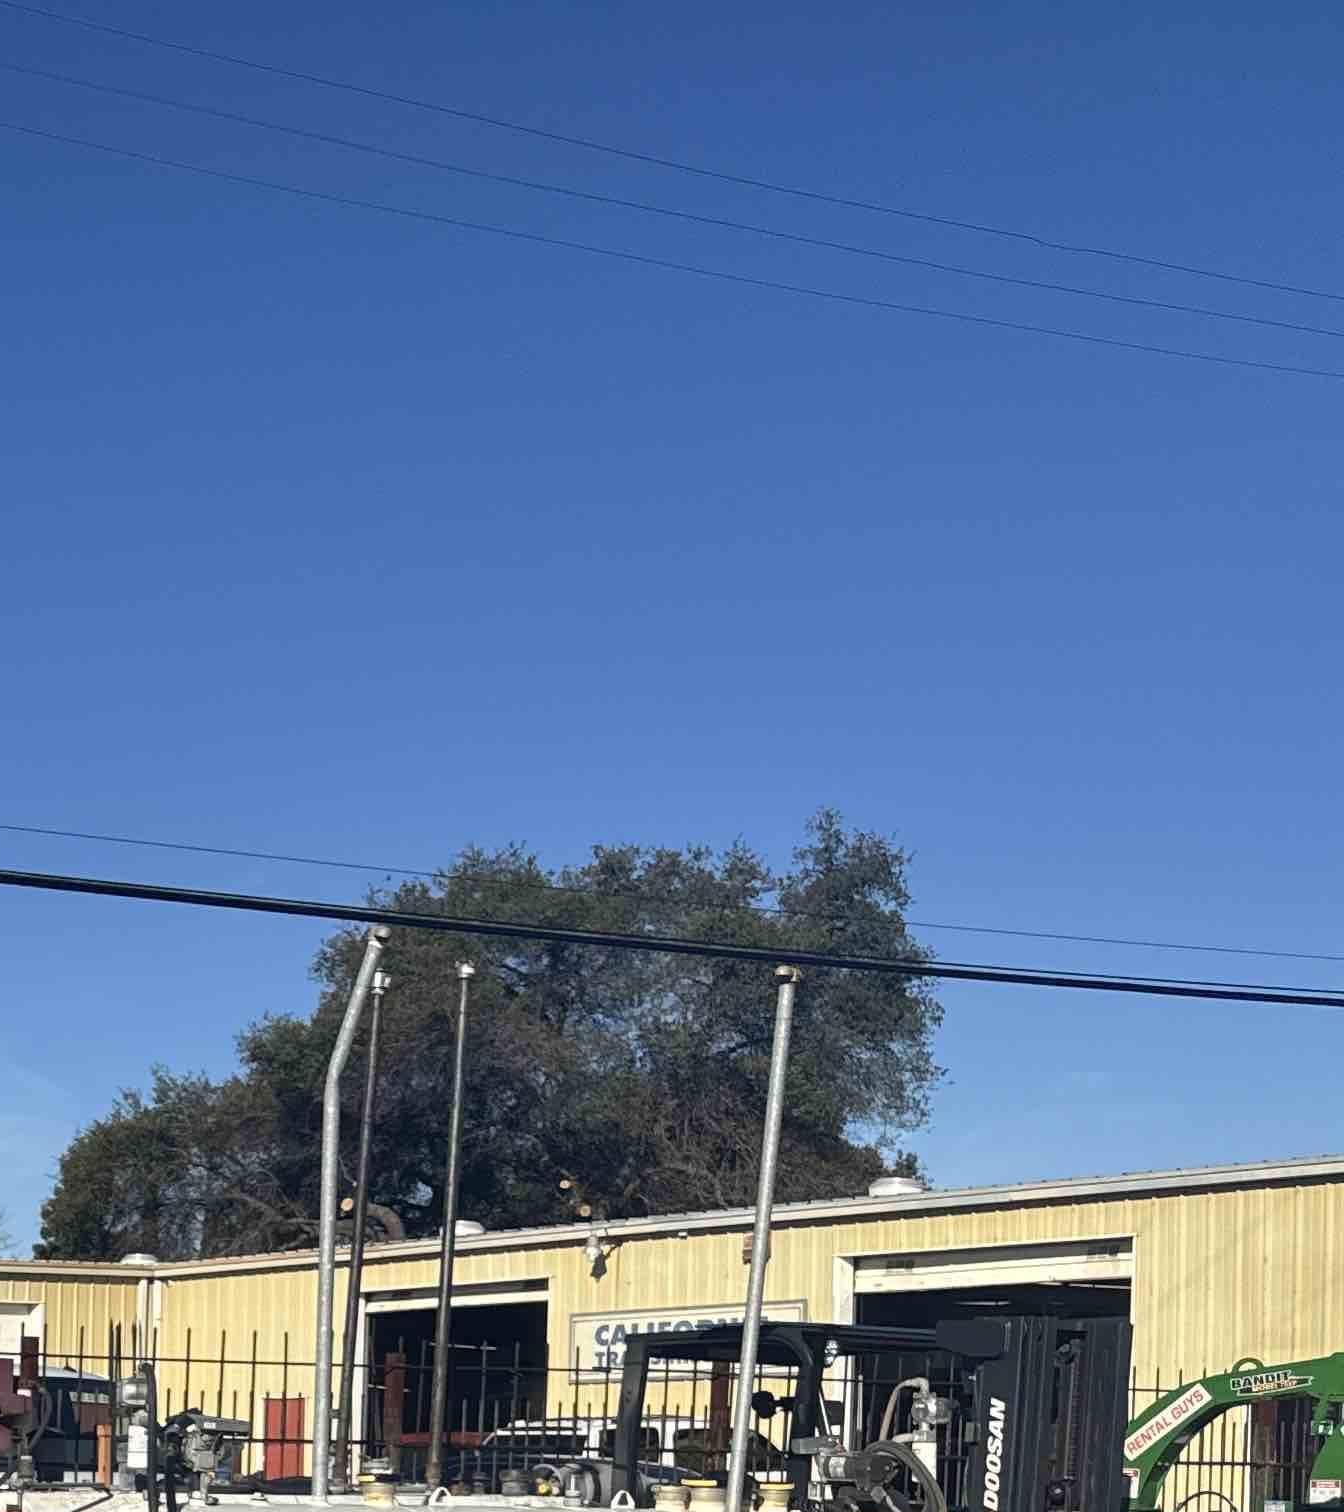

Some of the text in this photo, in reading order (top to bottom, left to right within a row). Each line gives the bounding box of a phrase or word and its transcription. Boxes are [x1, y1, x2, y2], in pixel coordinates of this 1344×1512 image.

[1232, 1371, 1291, 1389] BANDIT
[983, 1397, 1006, 1512] DOOSAN
[1126, 1390, 1206, 1456] RENTAL GUYS
